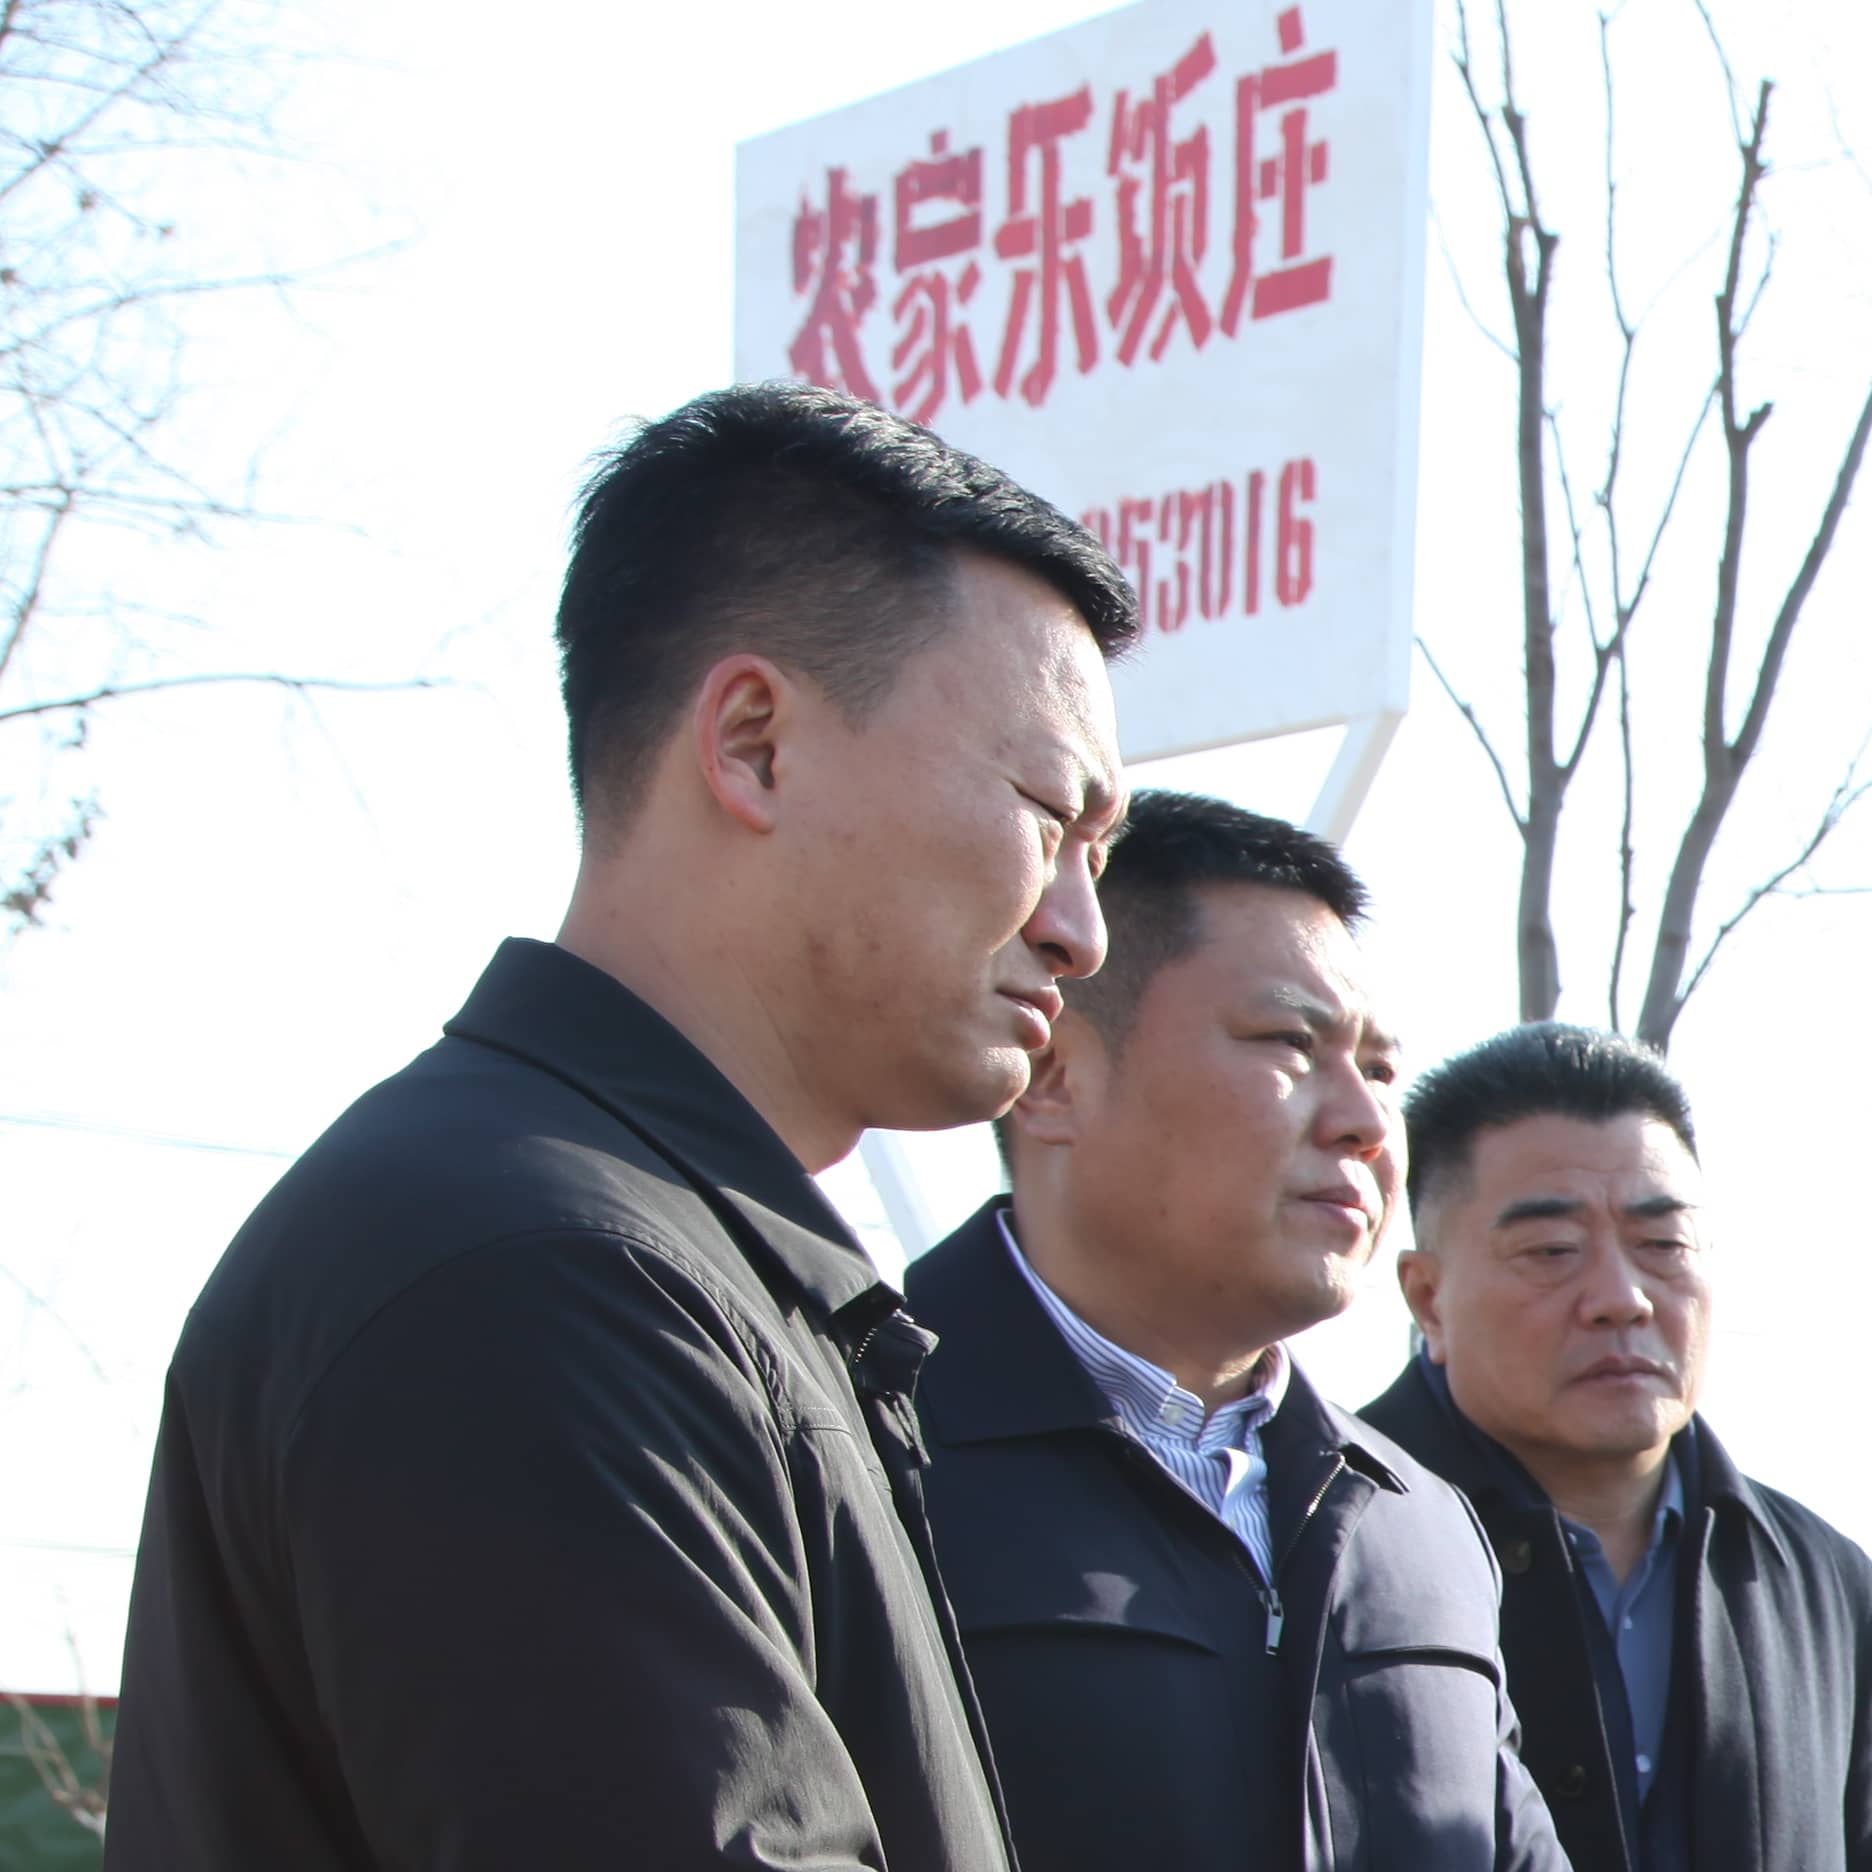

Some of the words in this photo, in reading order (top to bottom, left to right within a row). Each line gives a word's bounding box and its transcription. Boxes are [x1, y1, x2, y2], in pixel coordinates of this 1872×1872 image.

[787, 4, 1337, 427] 农家乐饭庄
